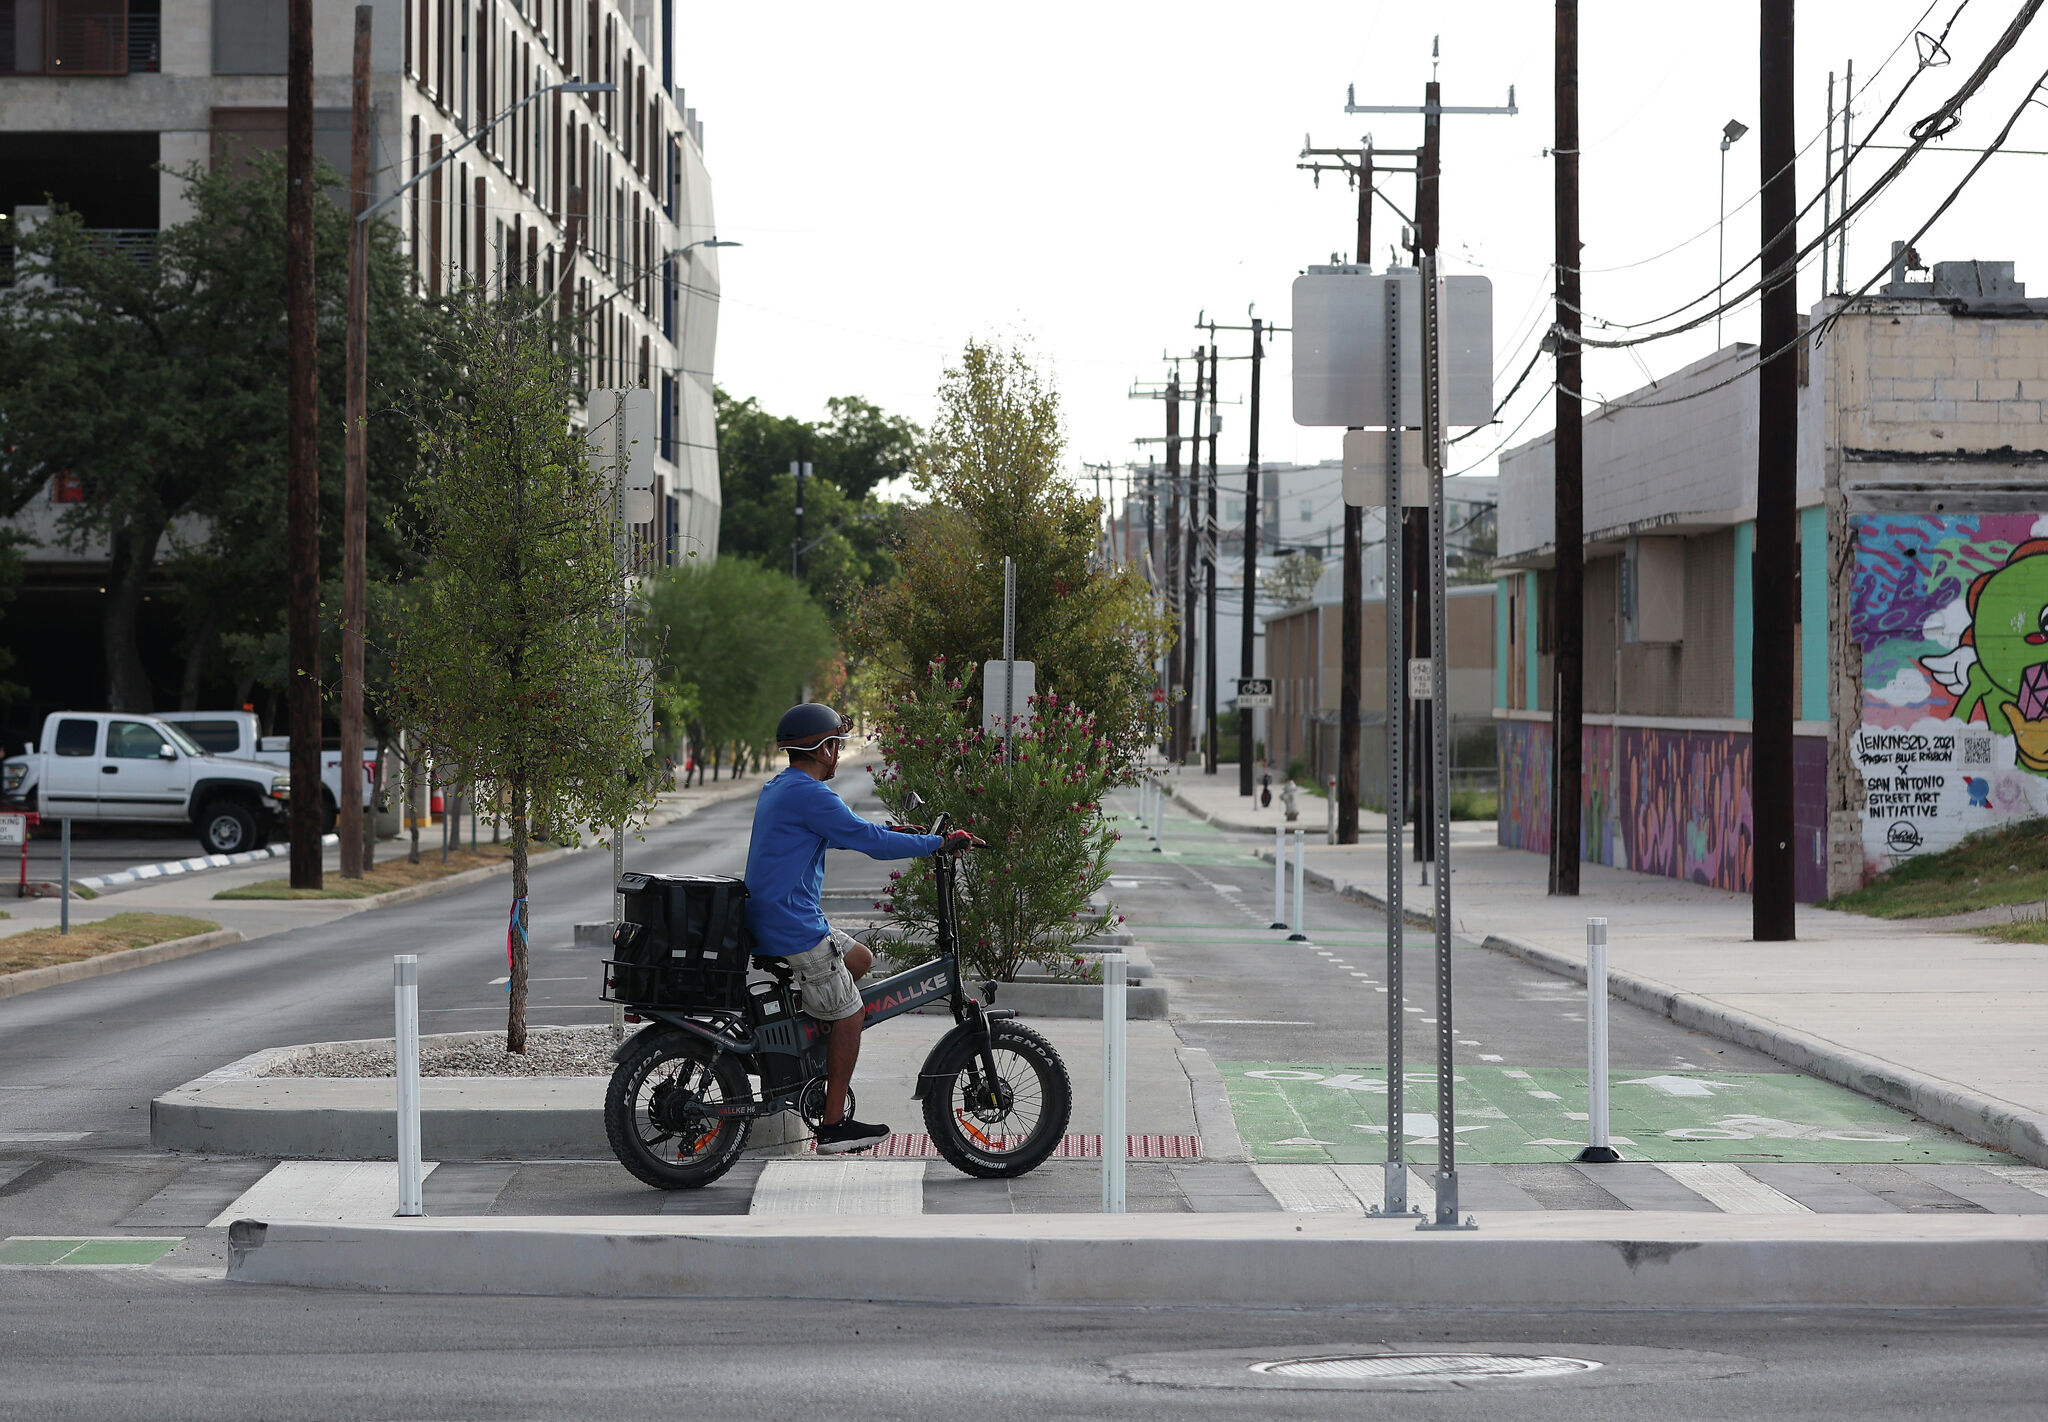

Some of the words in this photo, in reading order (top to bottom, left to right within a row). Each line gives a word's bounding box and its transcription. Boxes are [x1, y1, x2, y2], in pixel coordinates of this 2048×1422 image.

[1933, 735, 1955, 749] 2021
[1859, 753, 1892, 766] PABST
[1895, 751, 1917, 763] BLUE
[1919, 750, 1952, 762] RIBBON
[1867, 777, 1890, 792] SAN
[1895, 775, 1945, 791] ANTONIO
[1869, 792, 1911, 805] STREET
[1914, 792, 1941, 803] ART
[1869, 805, 1938, 818] INITIATIVE
[865, 972, 948, 1015] WALLKE
[999, 1033, 1054, 1067] KENDA
[623, 1049, 663, 1107] KENDA
[717, 1106, 746, 1114] WALLKE
[746, 1105, 756, 1113] H6
[965, 1153, 1000, 1169] KRUSADE
